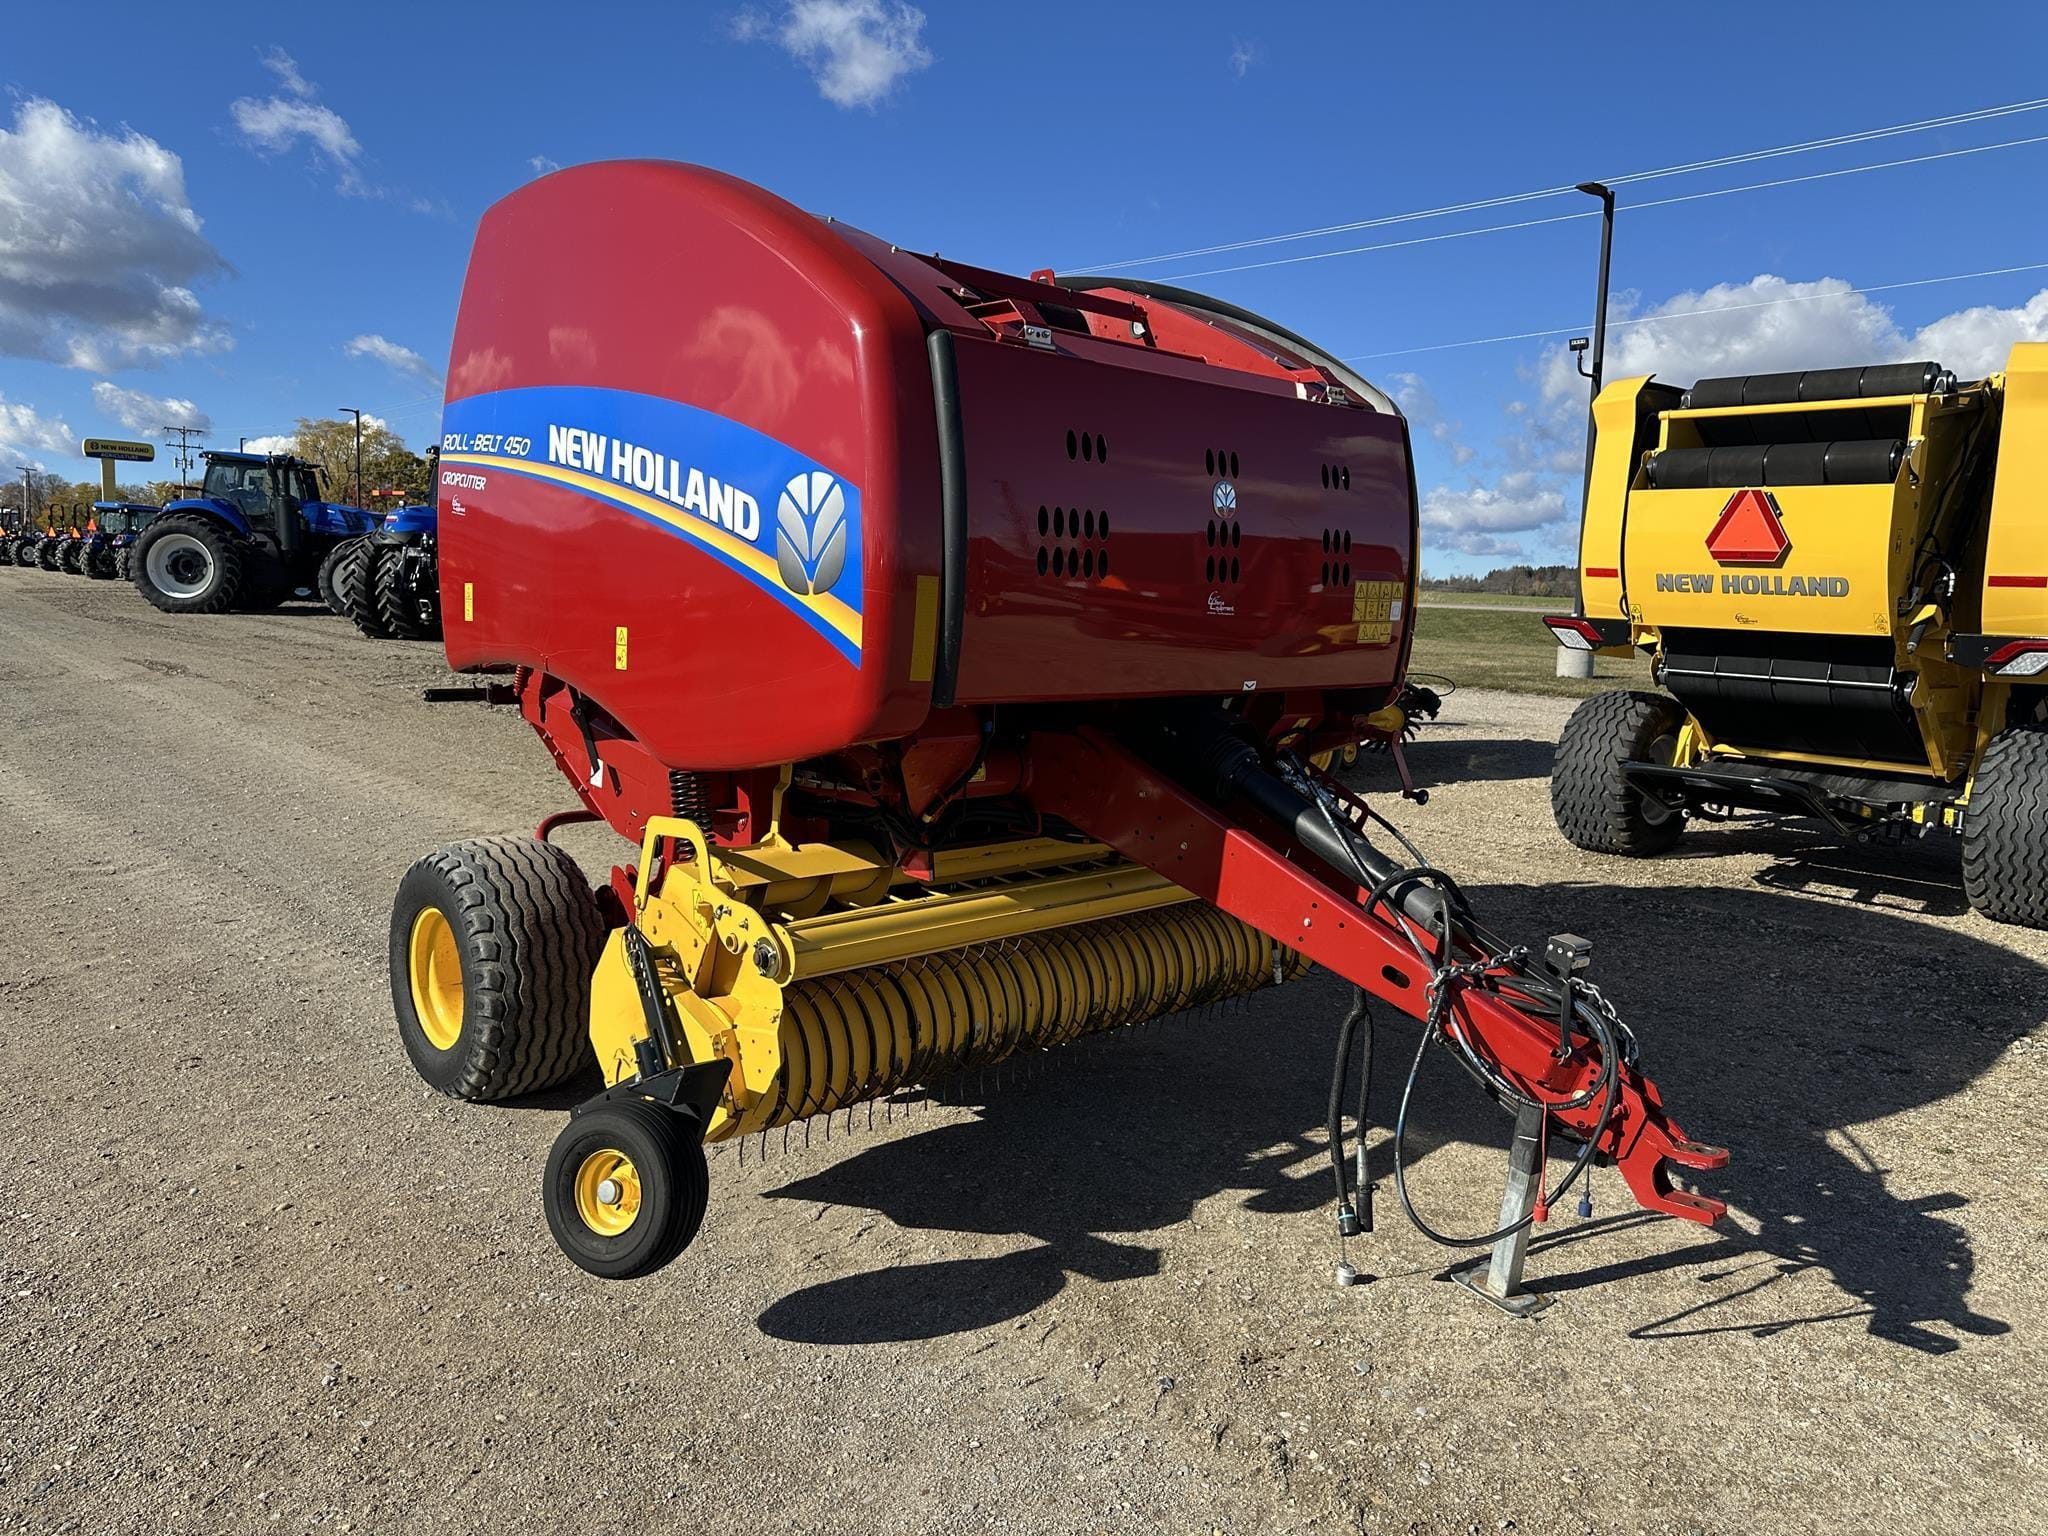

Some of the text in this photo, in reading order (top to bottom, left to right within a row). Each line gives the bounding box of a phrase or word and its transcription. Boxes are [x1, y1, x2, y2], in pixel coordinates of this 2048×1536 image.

[118, 445, 149, 453] HOLLAND
[442, 433, 531, 456] ROLL-BELT 450
[441, 471, 487, 491] CROPCUTTER
[549, 424, 760, 542] NEW HOLLAND
[1656, 573, 1850, 597] NEW HOLLAND
